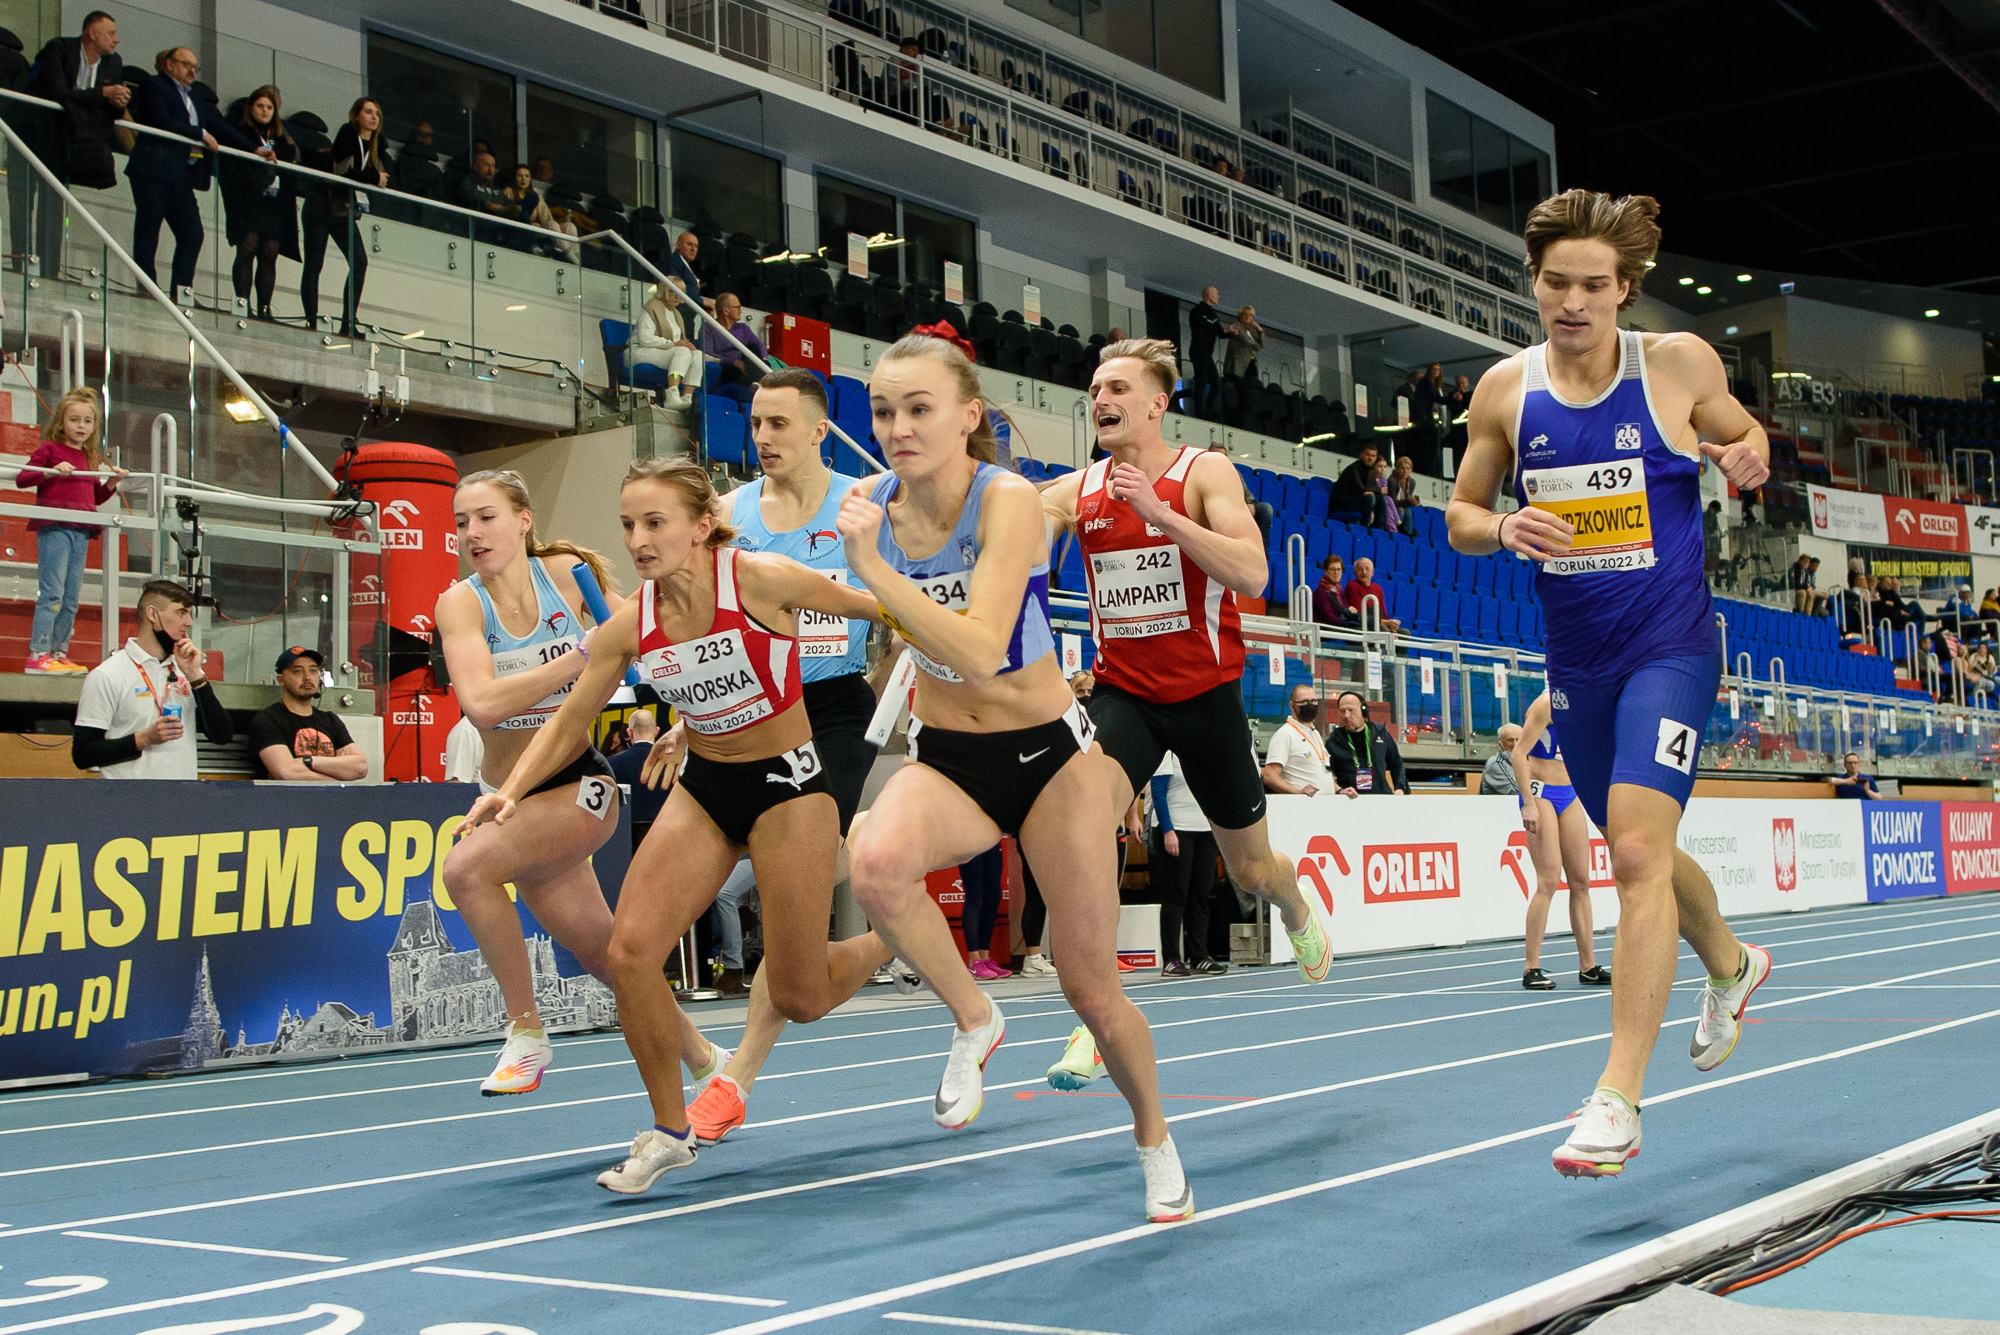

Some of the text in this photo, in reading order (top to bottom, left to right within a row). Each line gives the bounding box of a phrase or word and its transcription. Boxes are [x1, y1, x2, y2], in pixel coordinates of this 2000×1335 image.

[1811, 380, 1836, 405] B3
[1540, 480, 1573, 493] TORUŃ
[1587, 466, 1632, 491] 439
[1923, 517, 1957, 534] ORLEN
[1974, 514, 1991, 530] 4F
[1104, 561, 1126, 572] TORUŃ
[1135, 551, 1172, 571] 242
[1554, 556, 1633, 573] TORUŃ 2022
[1099, 581, 1180, 608] LAMPART
[1114, 621, 1173, 636] TORUŃ 2022
[538, 642, 573, 665] 100
[695, 637, 734, 665] 233
[804, 645, 831, 654] 2022
[496, 659, 527, 672] TORUŃ
[497, 657, 521, 665] MIASTO
[653, 665, 680, 679] ORLEN
[395, 714, 431, 723] ORLEN
[505, 714, 546, 728] TORUŃ
[723, 710, 754, 729] 2022
[1075, 700, 1092, 739] 4
[1666, 728, 1687, 766] 4
[793, 748, 816, 774] 5
[585, 781, 606, 811] 3
[1530, 781, 1540, 796] 6
[1870, 811, 1923, 844] KUJAWY
[1949, 811, 1993, 842] KUJAWY
[1684, 833, 1738, 855] Ministerstwo
[1800, 830, 1843, 850] Ministerstwo
[1367, 850, 1455, 896] ORLEN
[1801, 859, 1824, 884] Sportu
[1830, 857, 1858, 882] Turystyki
[1873, 851, 1937, 887] POMORZE
[1951, 847, 2000, 881] POMORZ
[1721, 864, 1757, 890] Turystyki
